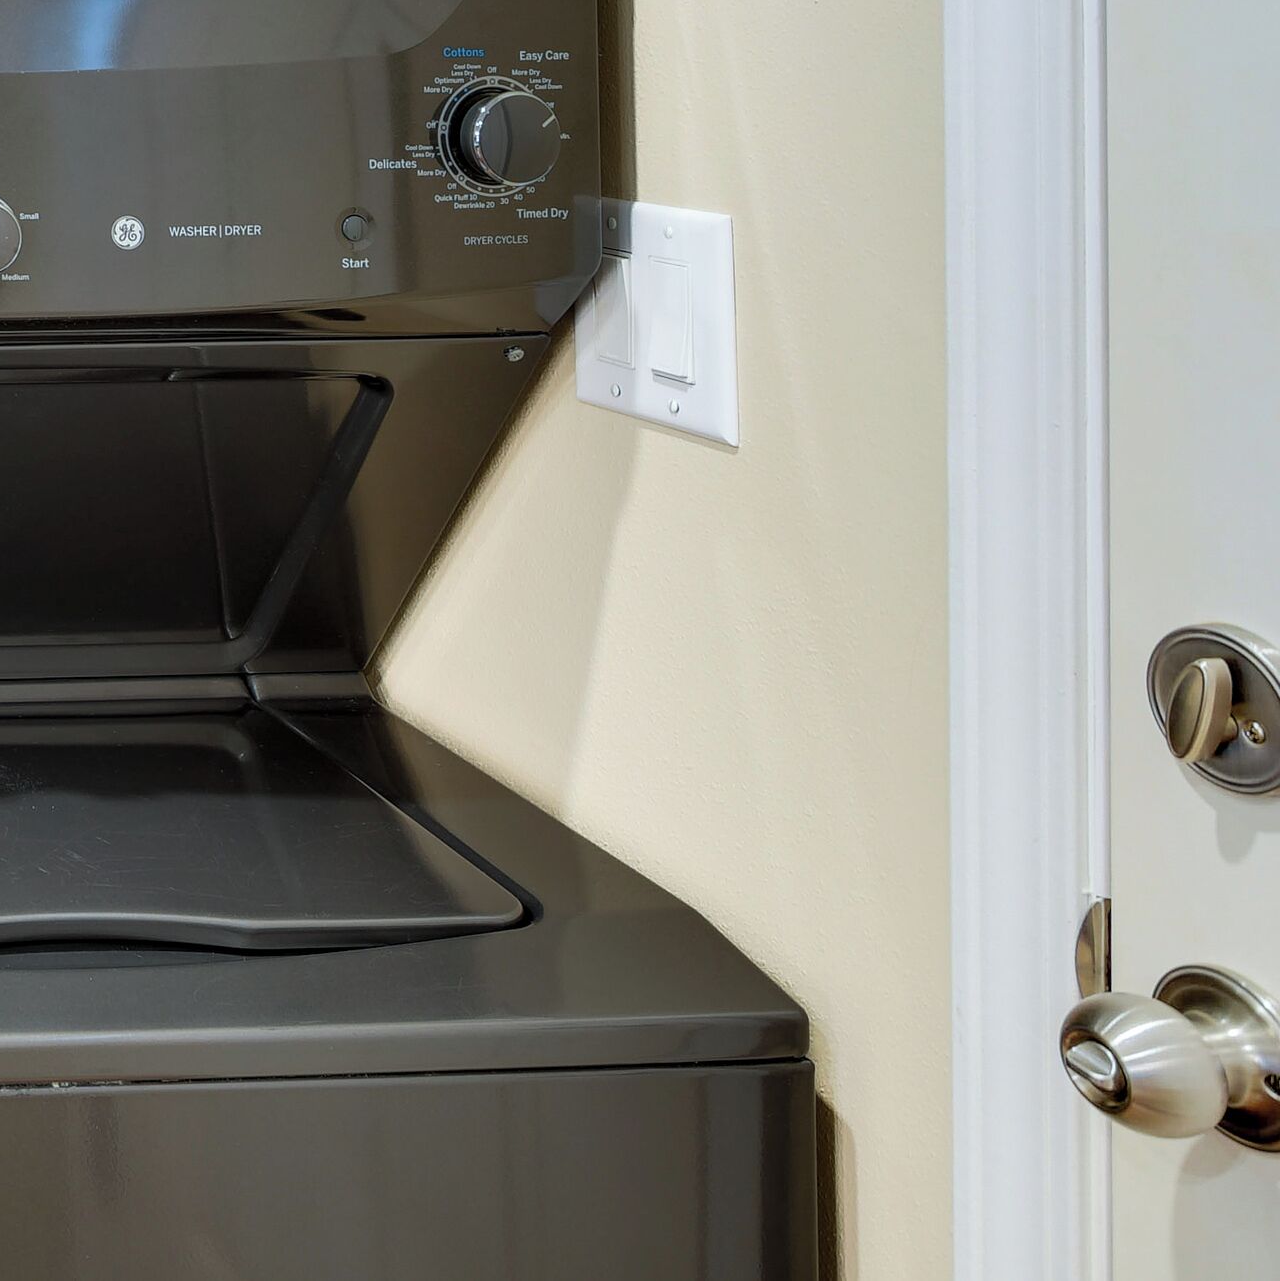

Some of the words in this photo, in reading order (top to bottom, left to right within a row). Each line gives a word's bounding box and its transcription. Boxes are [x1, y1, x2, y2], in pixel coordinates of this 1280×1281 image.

[443, 47, 485, 58] Cottons
[519, 50, 543, 62] Easy
[545, 50, 570, 61] Care
[528, 69, 541, 77] Dry
[426, 121, 437, 129] Off
[369, 159, 417, 170] Delicates
[435, 170, 447, 178] Dry
[526, 186, 536, 194] 50
[486, 201, 496, 209] 20
[19, 213, 39, 221] Small
[516, 208, 548, 219] Timed
[550, 208, 569, 220] Dry
[169, 226, 217, 237] WASHER
[224, 225, 262, 236] DRYER
[464, 236, 494, 246] DRYER
[495, 235, 529, 245] CYCLES
[342, 258, 369, 269] Start
